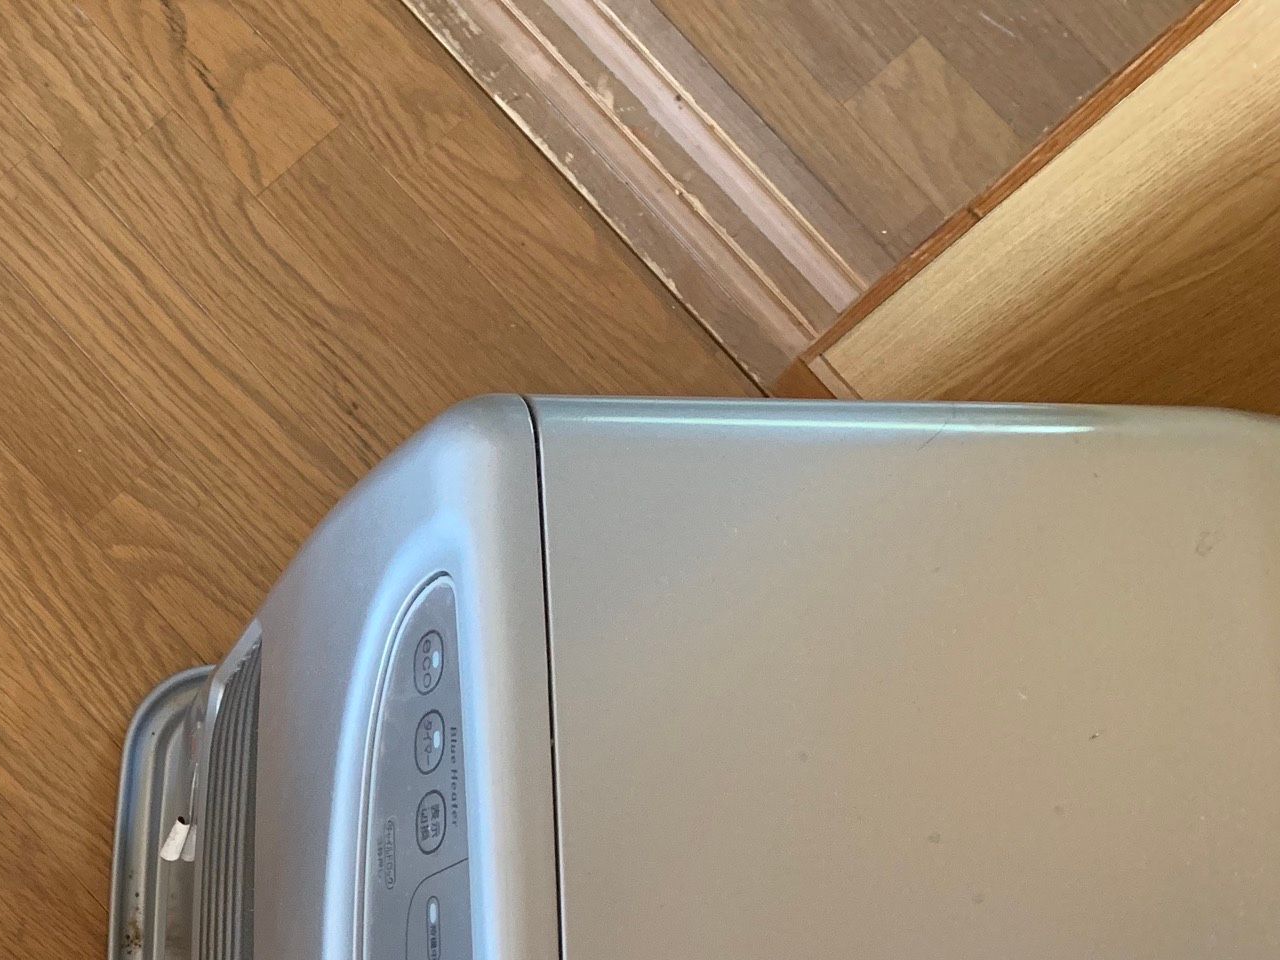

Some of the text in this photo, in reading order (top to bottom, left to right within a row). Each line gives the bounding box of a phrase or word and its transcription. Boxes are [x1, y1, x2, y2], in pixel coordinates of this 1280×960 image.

[422, 720, 433, 766] タイマー
[450, 727, 459, 827] Blue Heater
[431, 804, 441, 838] 表示
